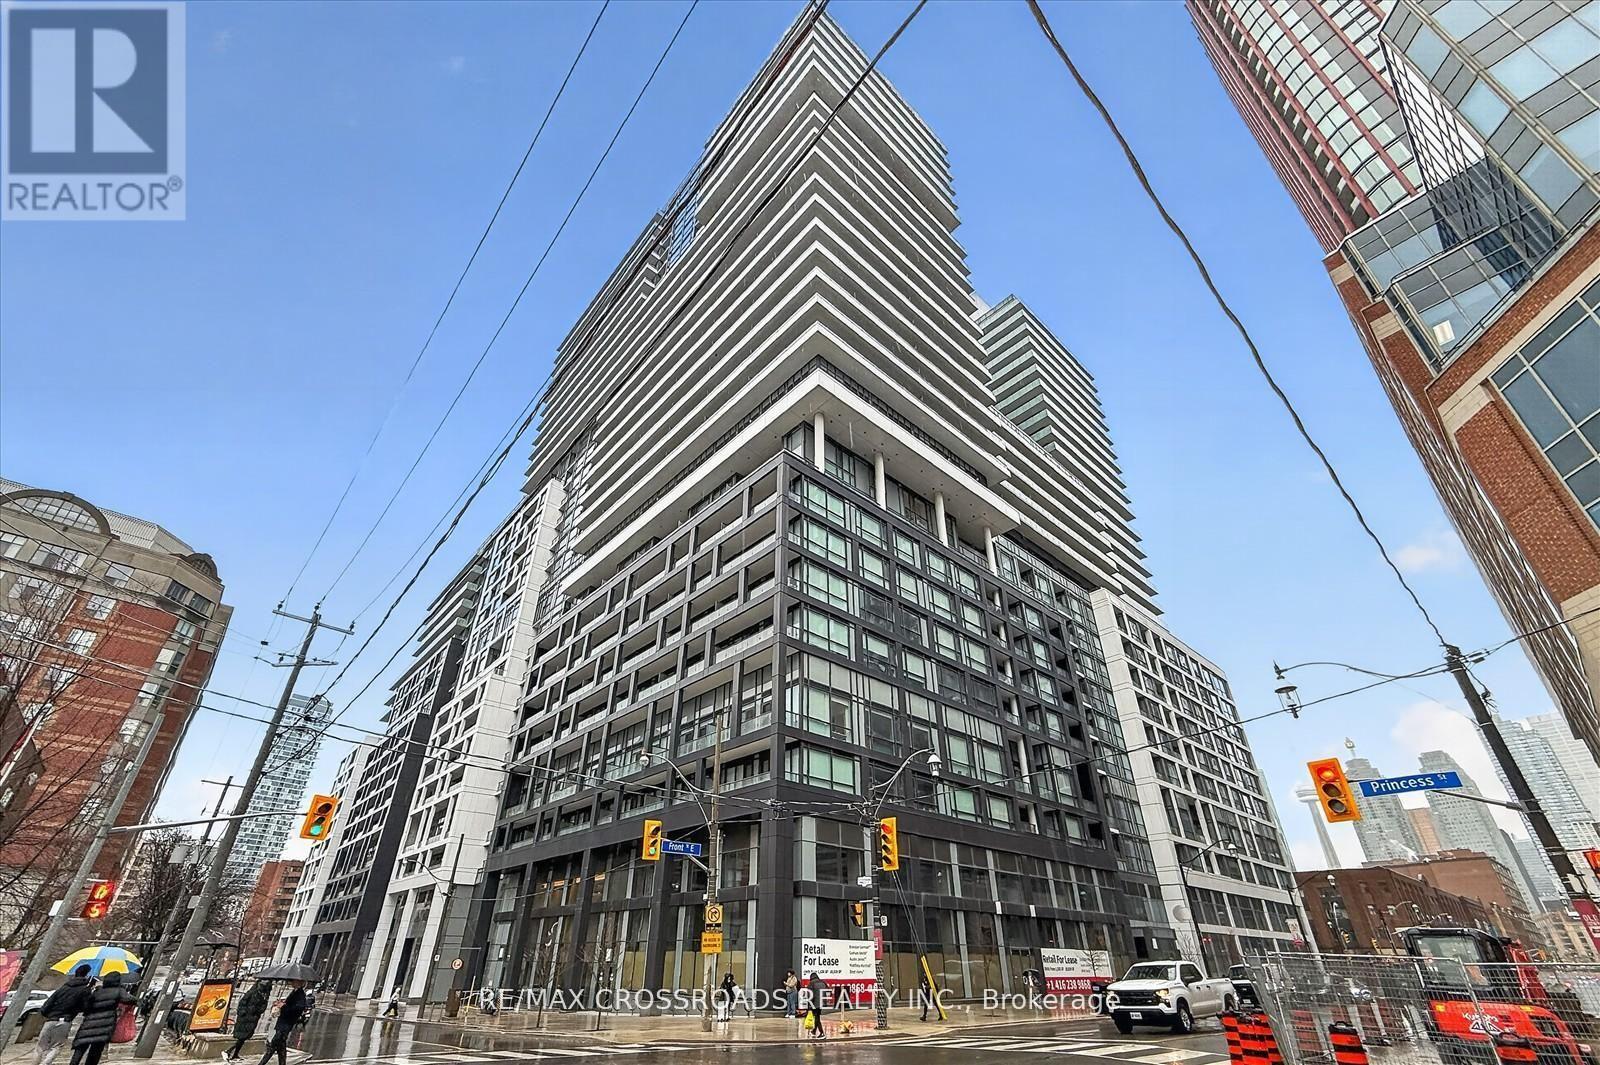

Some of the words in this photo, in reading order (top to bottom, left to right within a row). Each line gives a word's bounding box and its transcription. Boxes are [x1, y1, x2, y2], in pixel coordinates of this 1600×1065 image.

[1370, 777, 1434, 792] Princess
[668, 842, 685, 852] Front
[690, 844, 695, 853] E
[803, 943, 826, 955] Retail
[803, 955, 817, 966] For
[818, 956, 840, 966] Lease
[1043, 955, 1056, 964] Retail
[1056, 955, 1065, 964] For
[1065, 955, 1078, 965] Lease
[1046, 980, 1055, 990] +1
[1055, 980, 1067, 990] 416
[1066, 980, 1078, 990] 238
